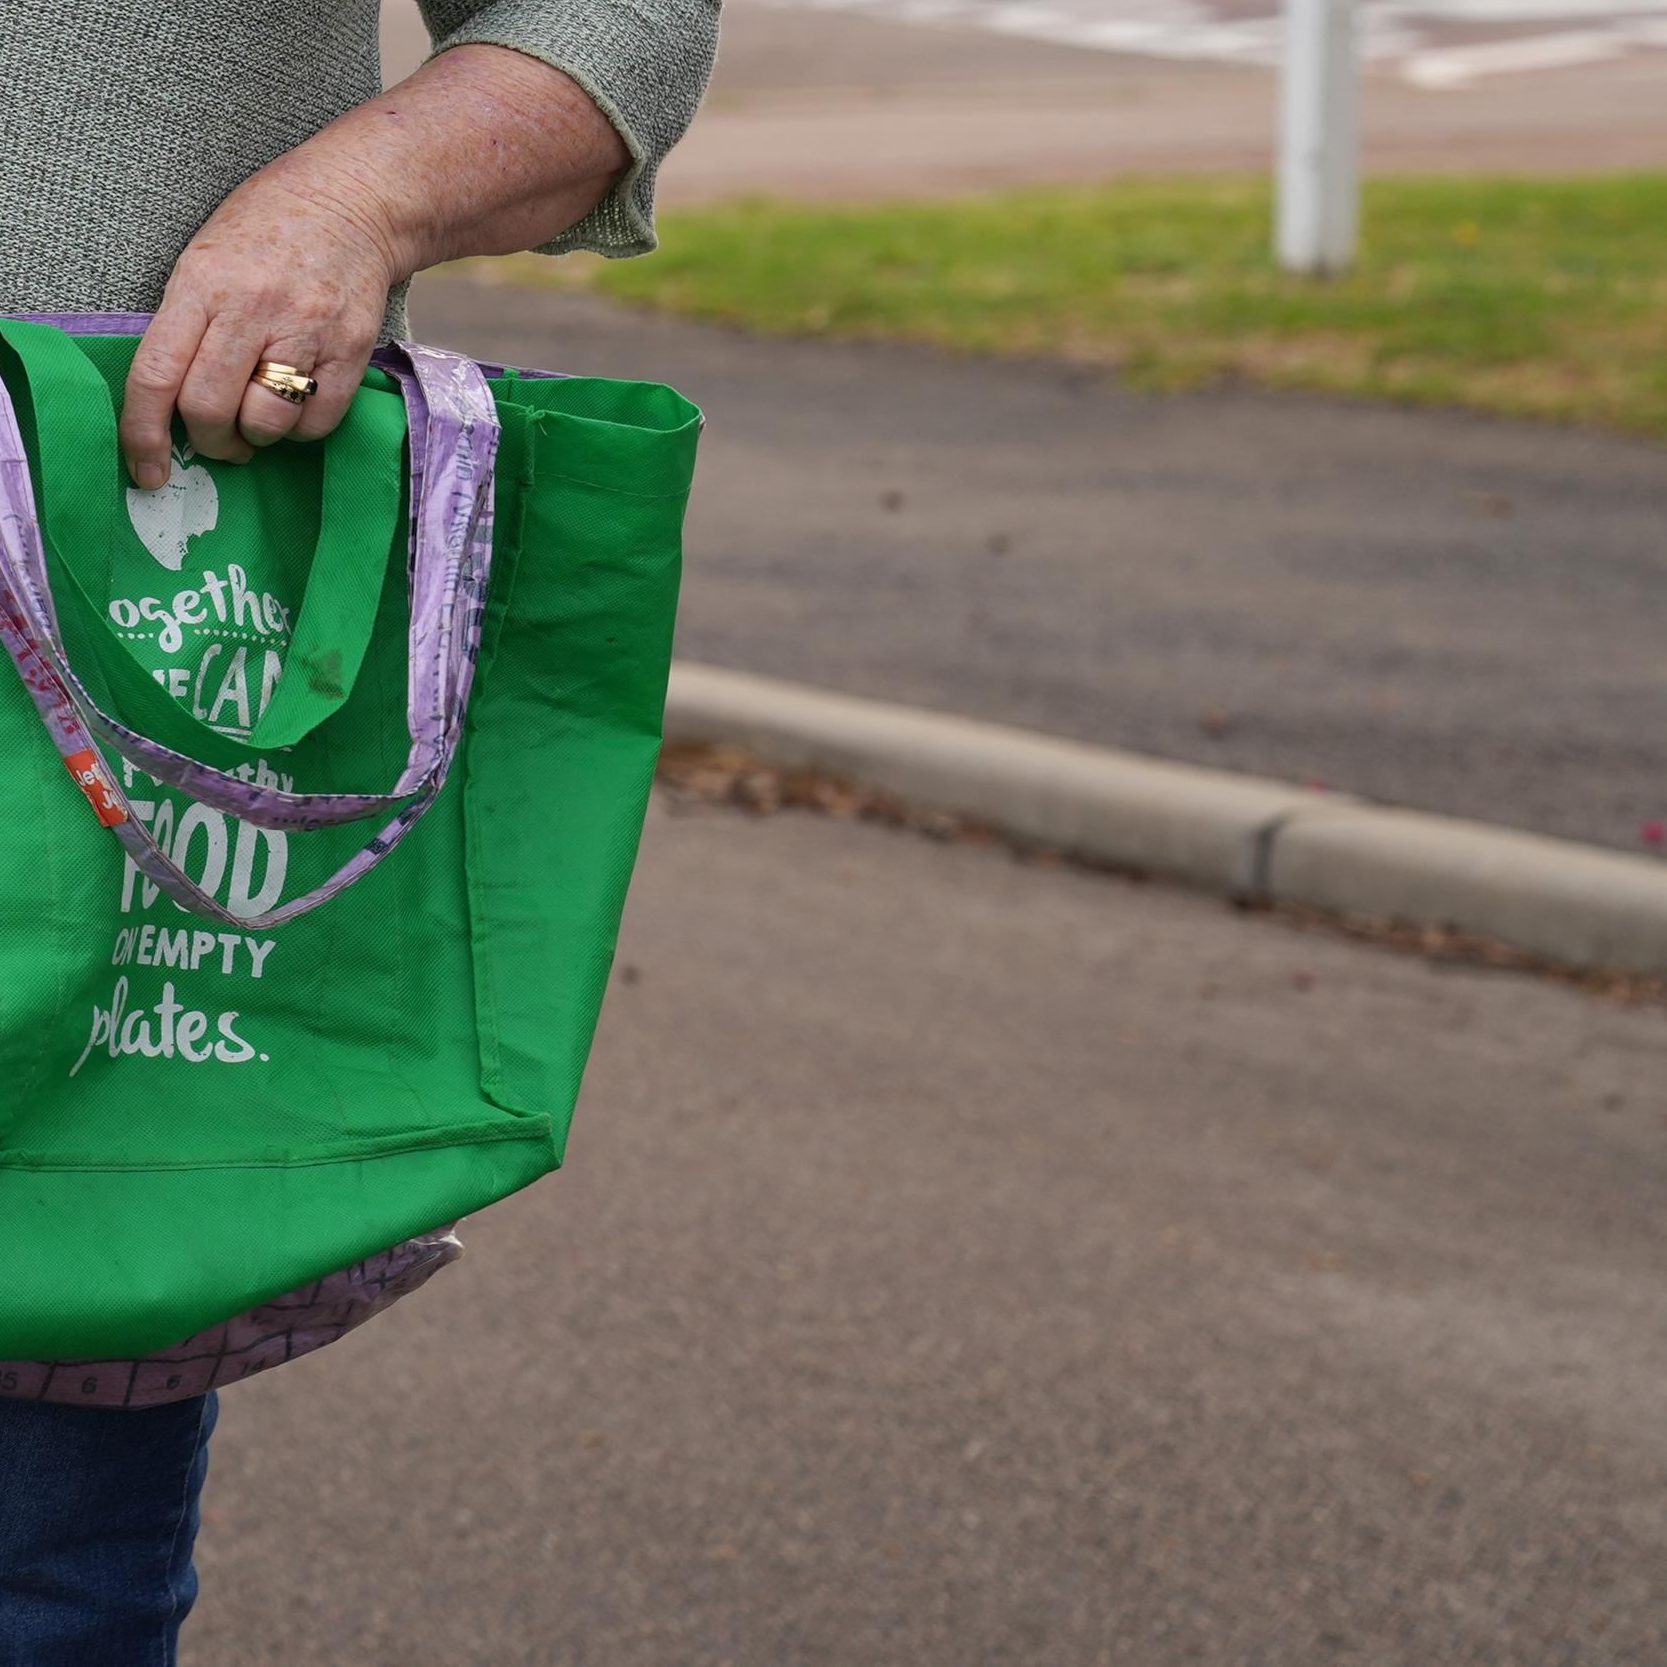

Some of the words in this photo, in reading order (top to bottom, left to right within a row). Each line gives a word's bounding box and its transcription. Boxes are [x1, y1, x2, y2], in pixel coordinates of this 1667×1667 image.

[108, 563, 293, 654] ogether
[137, 924, 277, 979] EMPTY
[68, 974, 271, 1078] plates.
[80, 1376, 99, 1395] 6
